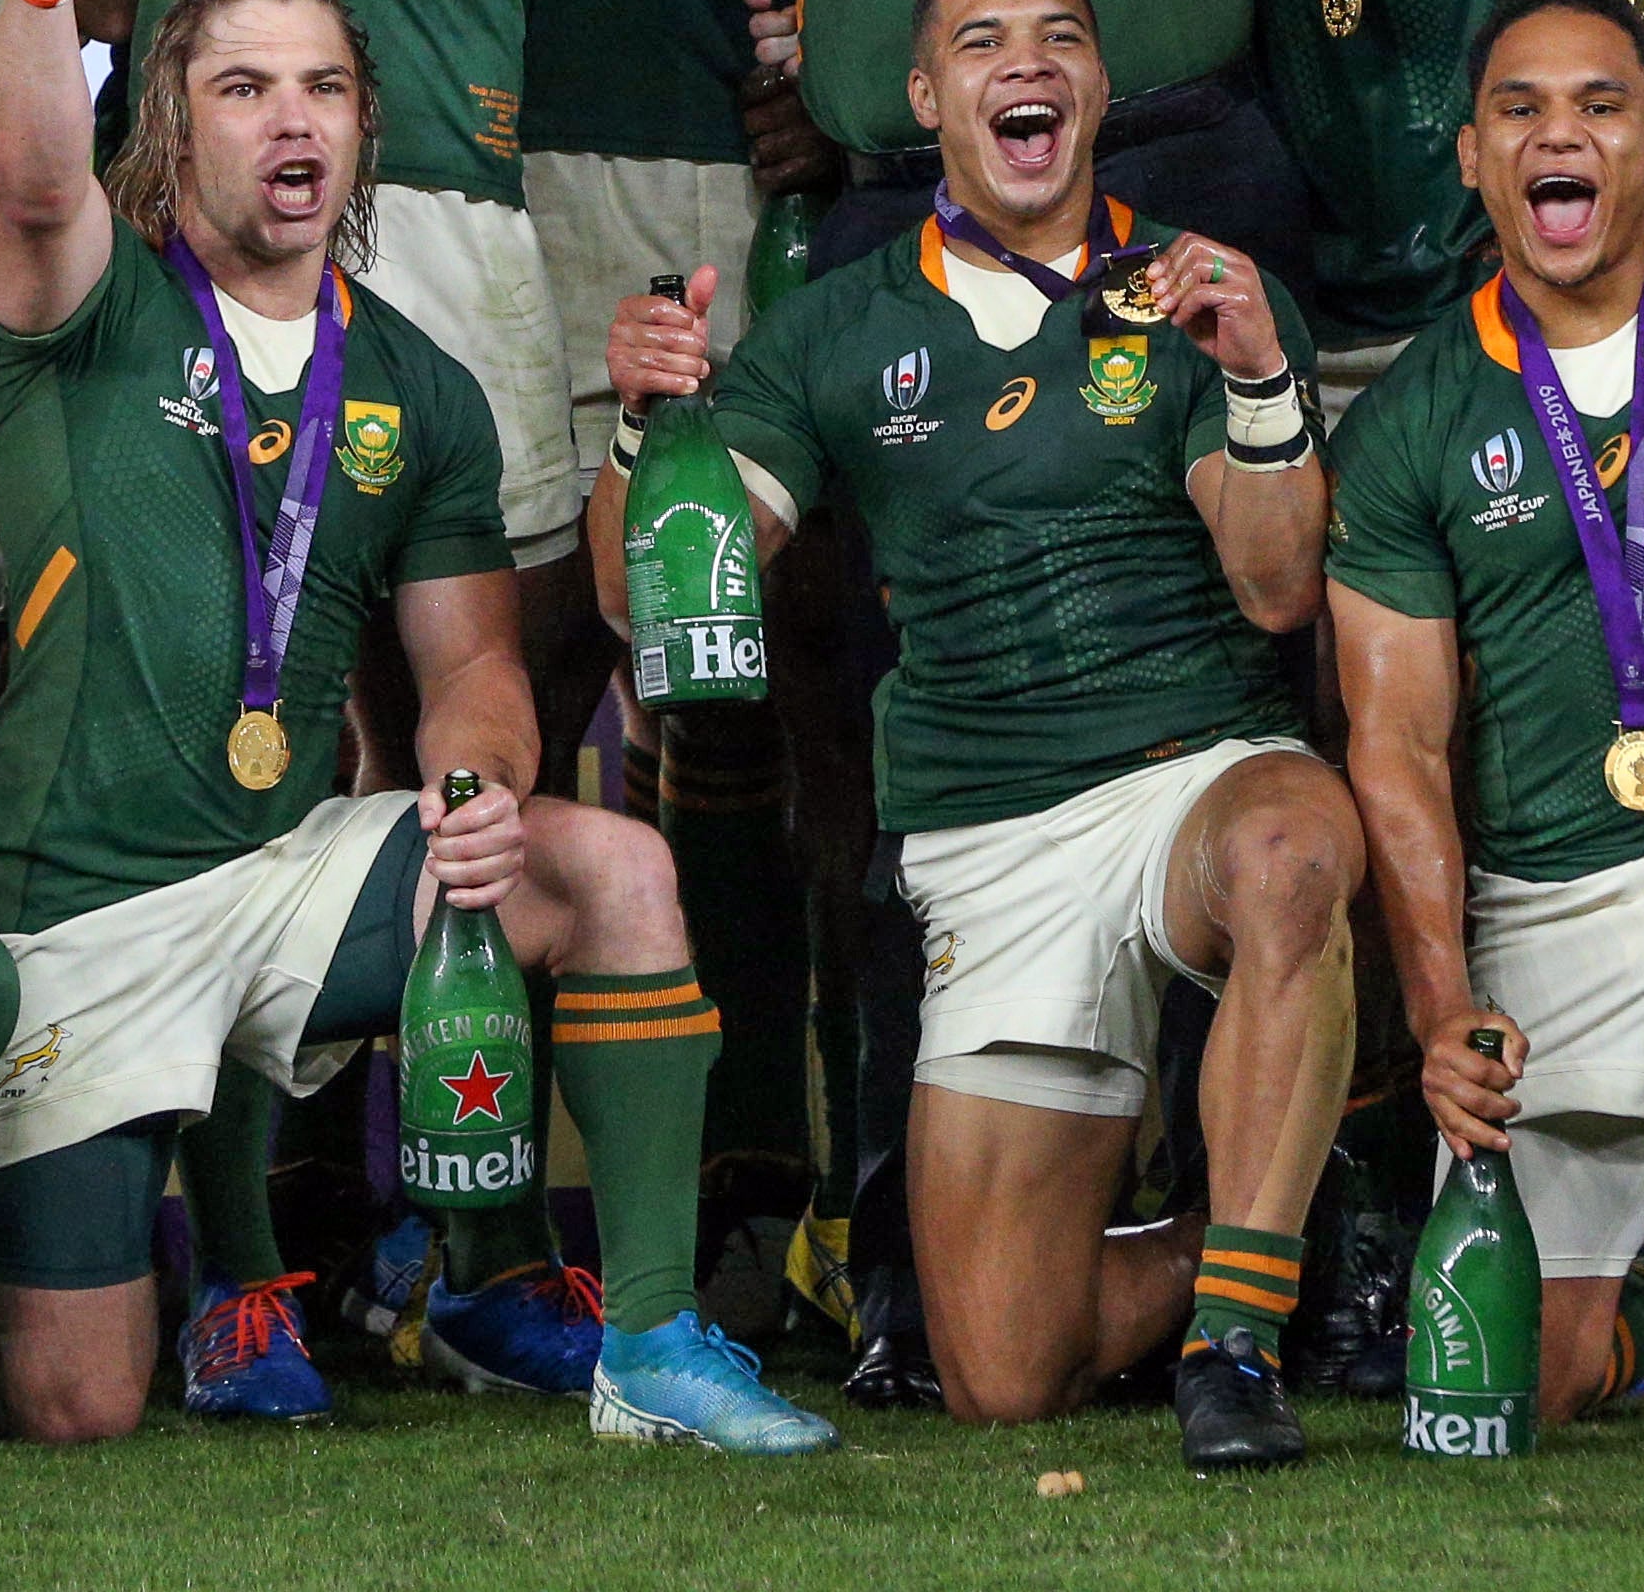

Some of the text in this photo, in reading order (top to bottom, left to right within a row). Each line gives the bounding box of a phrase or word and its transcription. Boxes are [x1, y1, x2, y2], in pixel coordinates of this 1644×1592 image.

[158, 396, 202, 423] WORLD
[889, 414, 919, 424] RUGBY
[1104, 416, 1136, 426] RUGBY
[872, 424, 914, 437] WORLD
[1489, 493, 1520, 509] RUGBY
[1471, 504, 1518, 525] WORLD
